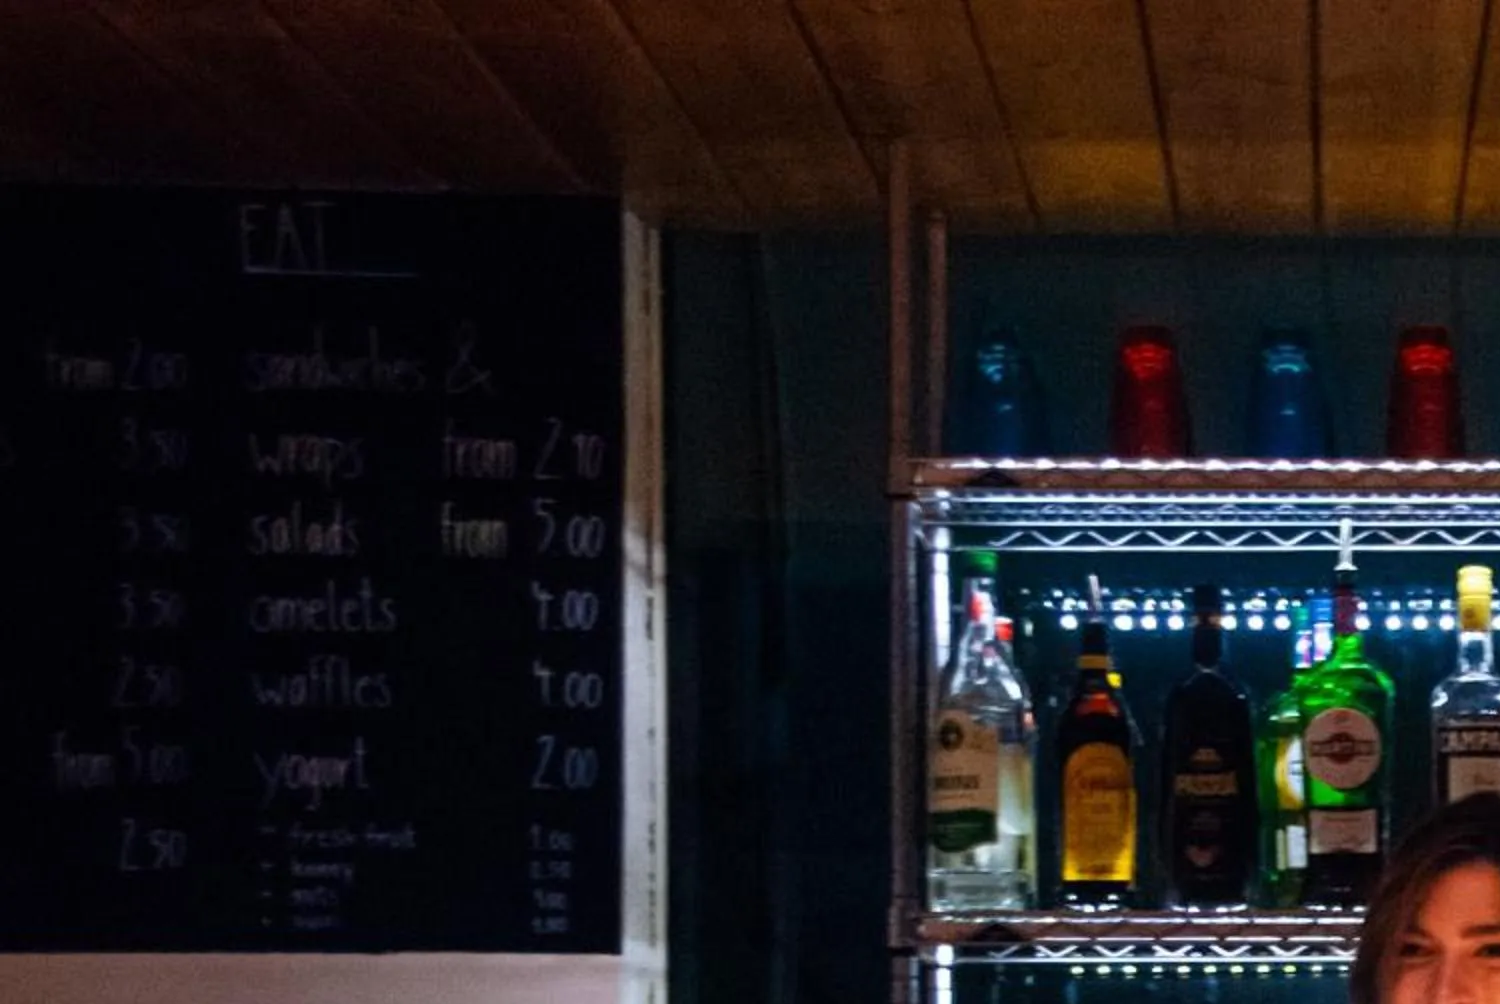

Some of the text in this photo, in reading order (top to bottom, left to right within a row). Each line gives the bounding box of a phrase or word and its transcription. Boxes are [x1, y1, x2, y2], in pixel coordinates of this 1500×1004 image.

[240, 201, 337, 271] EAT
[247, 432, 364, 490] wraps
[442, 417, 518, 480] from
[247, 499, 360, 555] salads
[250, 576, 399, 633] omelets
[251, 653, 393, 707] waffles
[253, 736, 370, 813] yogurt
